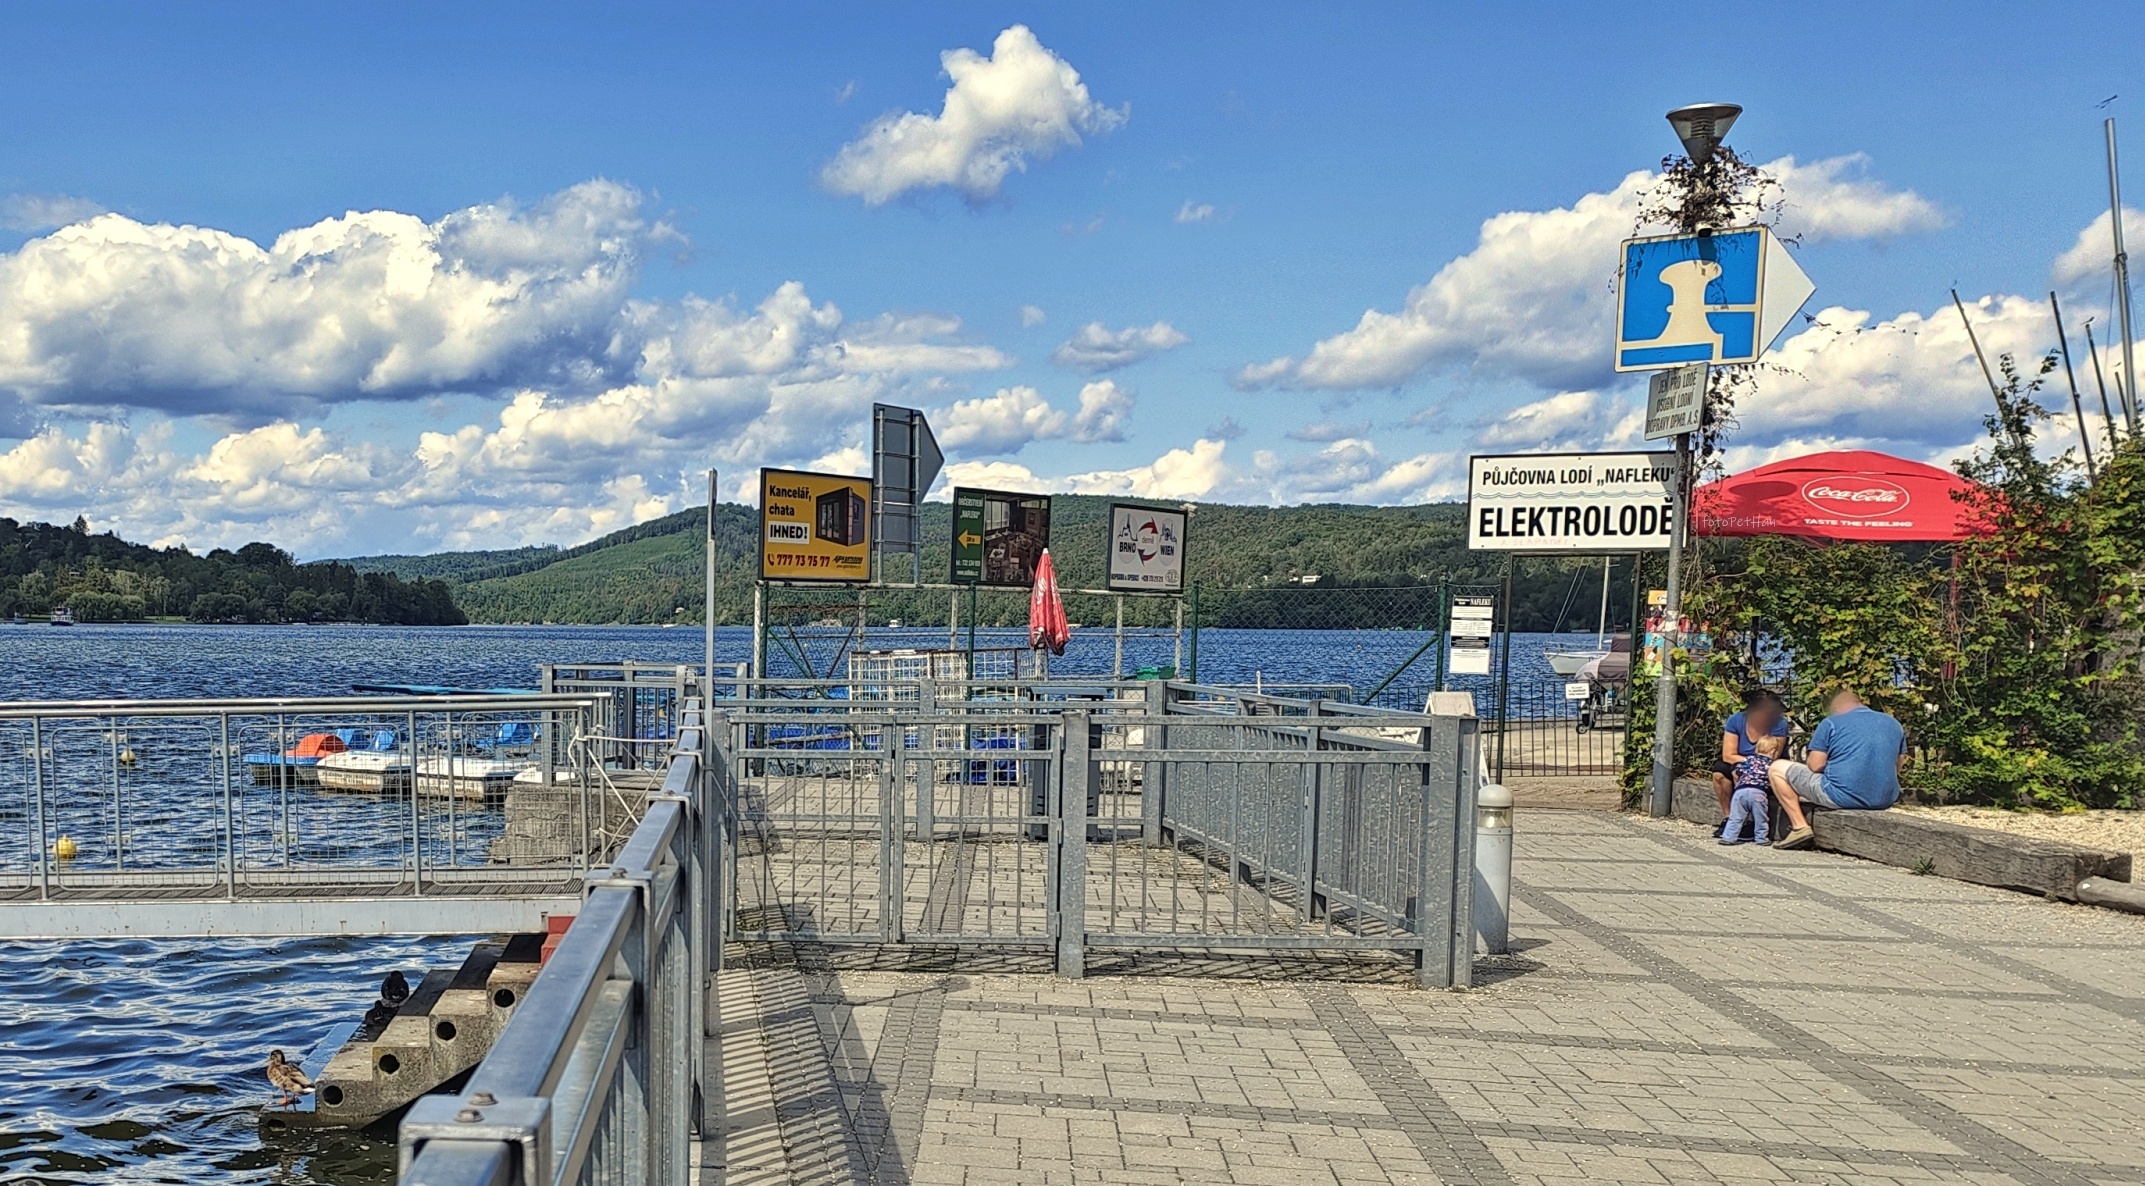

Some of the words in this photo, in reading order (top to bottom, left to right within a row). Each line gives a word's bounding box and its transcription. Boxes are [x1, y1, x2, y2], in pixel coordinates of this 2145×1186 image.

[1670, 375, 1681, 391] PRO
[1683, 368, 1697, 388] LODĚ
[1656, 391, 1677, 412] OSOBNÍ
[1677, 388, 1695, 408] LODNÍ
[1647, 415, 1670, 433] DOPRAVY
[1483, 466, 1555, 485] PŮJČOVNA
[1560, 465, 1593, 484] LODÍ
[769, 485, 811, 501] Kancelář,
[1808, 485, 1902, 503] Coca-Cola
[769, 503, 795, 516] chata
[1479, 497, 1673, 537] ELEKTROLODĚ
[1804, 518, 1838, 527] TASTE
[1840, 519, 1862, 527] THE
[769, 524, 808, 539] IHNED!
[1119, 542, 1136, 553] BRNO
[1160, 545, 1174, 556] WIEN
[777, 554, 793, 566] 777
[795, 554, 806, 566] 73
[808, 555, 818, 567] 75
[820, 556, 830, 567] 77
